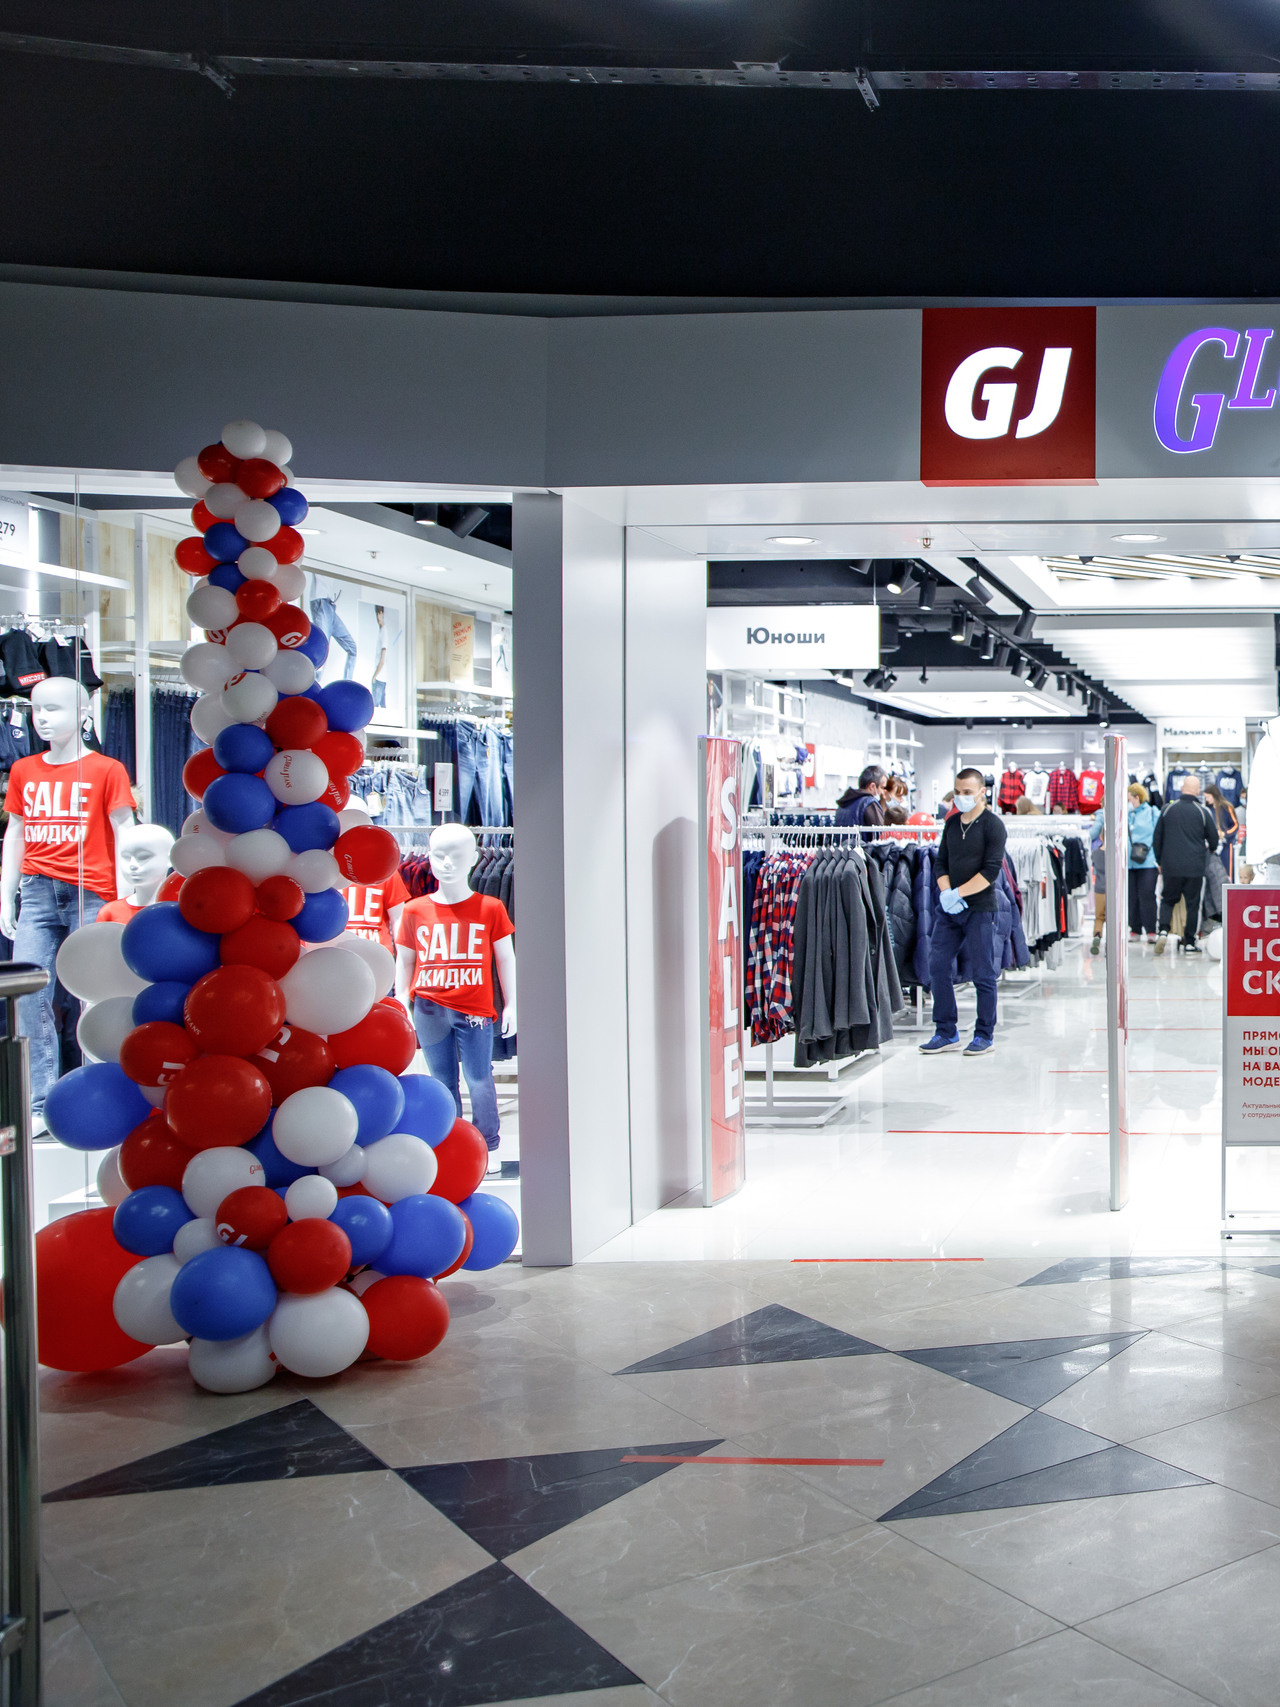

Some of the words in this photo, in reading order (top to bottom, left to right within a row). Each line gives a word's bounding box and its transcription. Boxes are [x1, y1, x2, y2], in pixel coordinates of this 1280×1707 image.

[943, 346, 1072, 440] GJ
[747, 627, 825, 644] Юноши
[23, 781, 92, 818] SALE
[24, 824, 88, 845] СКИДКИ
[342, 886, 384, 923] LE
[416, 922, 486, 962] SALE
[1242, 1046, 1264, 1056] МЫ
[1242, 1061, 1261, 1071] НА
